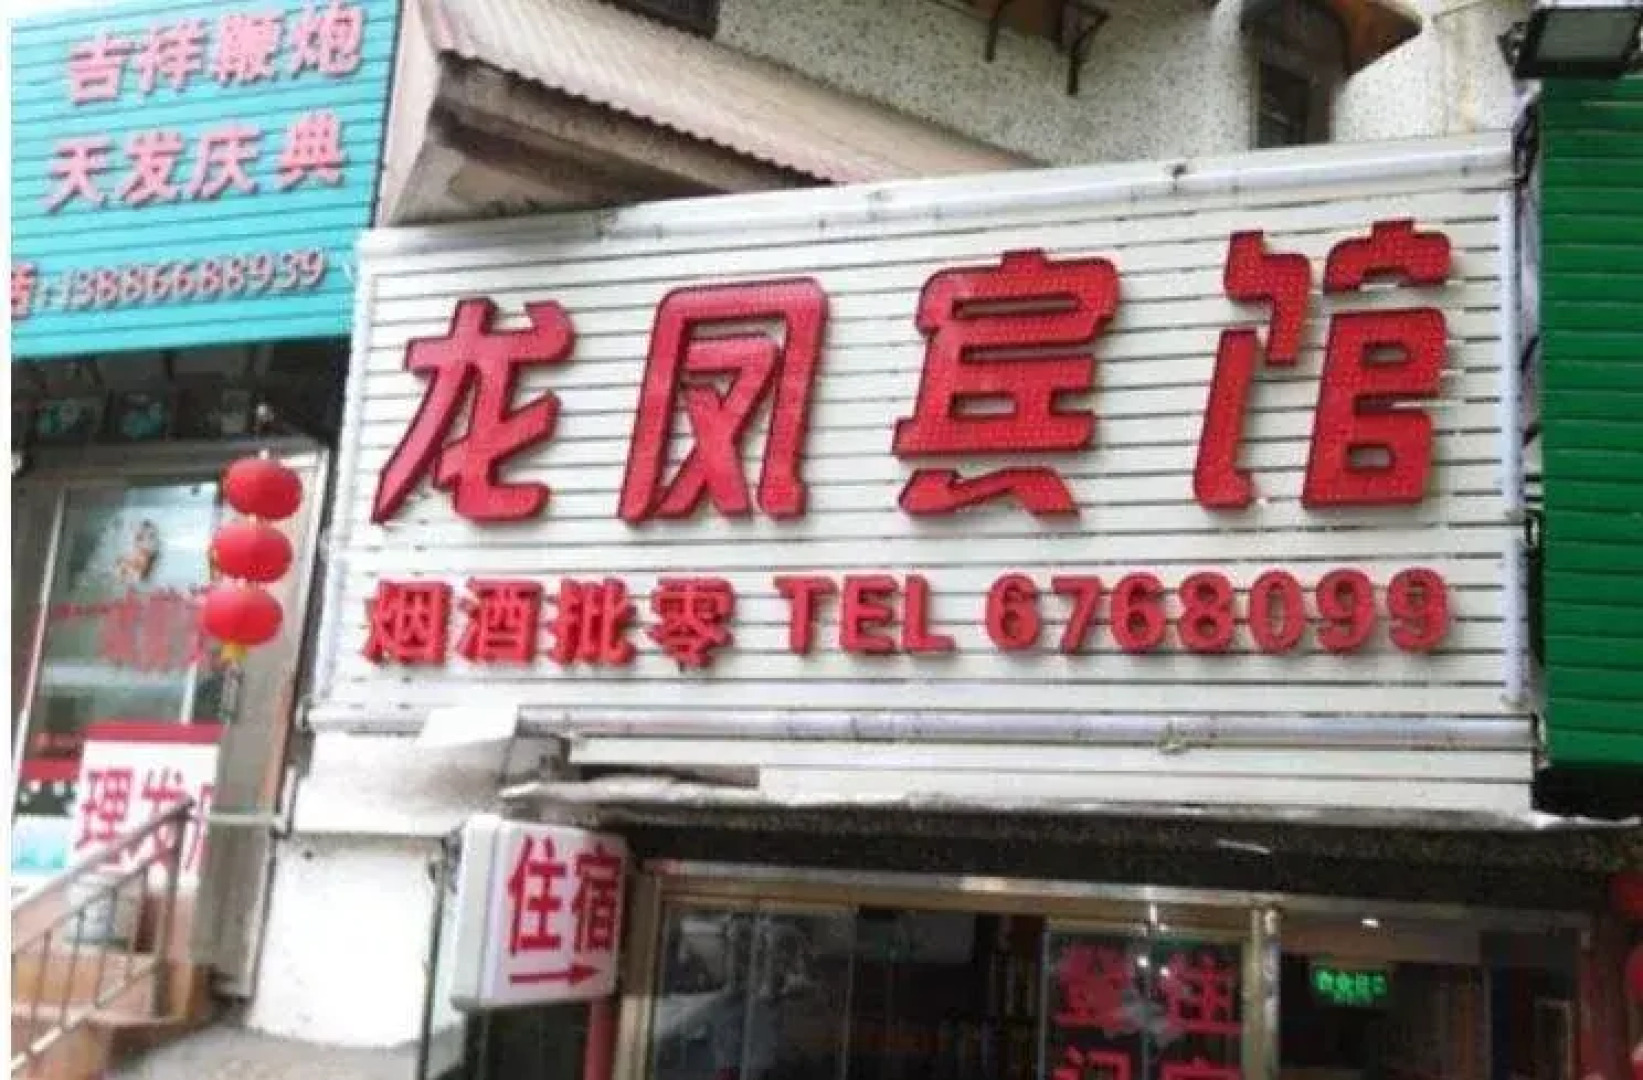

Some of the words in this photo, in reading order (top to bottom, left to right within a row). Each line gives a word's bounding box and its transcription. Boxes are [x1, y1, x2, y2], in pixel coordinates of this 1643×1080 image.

[41, 108, 346, 214] 天发庆典
[371, 219, 1453, 526] 龙凤宾馆
[362, 576, 737, 671] 烟酒批零
[774, 574, 956, 657] TEL
[984, 567, 1452, 656] 6768099
[507, 832, 623, 956] 住宿
